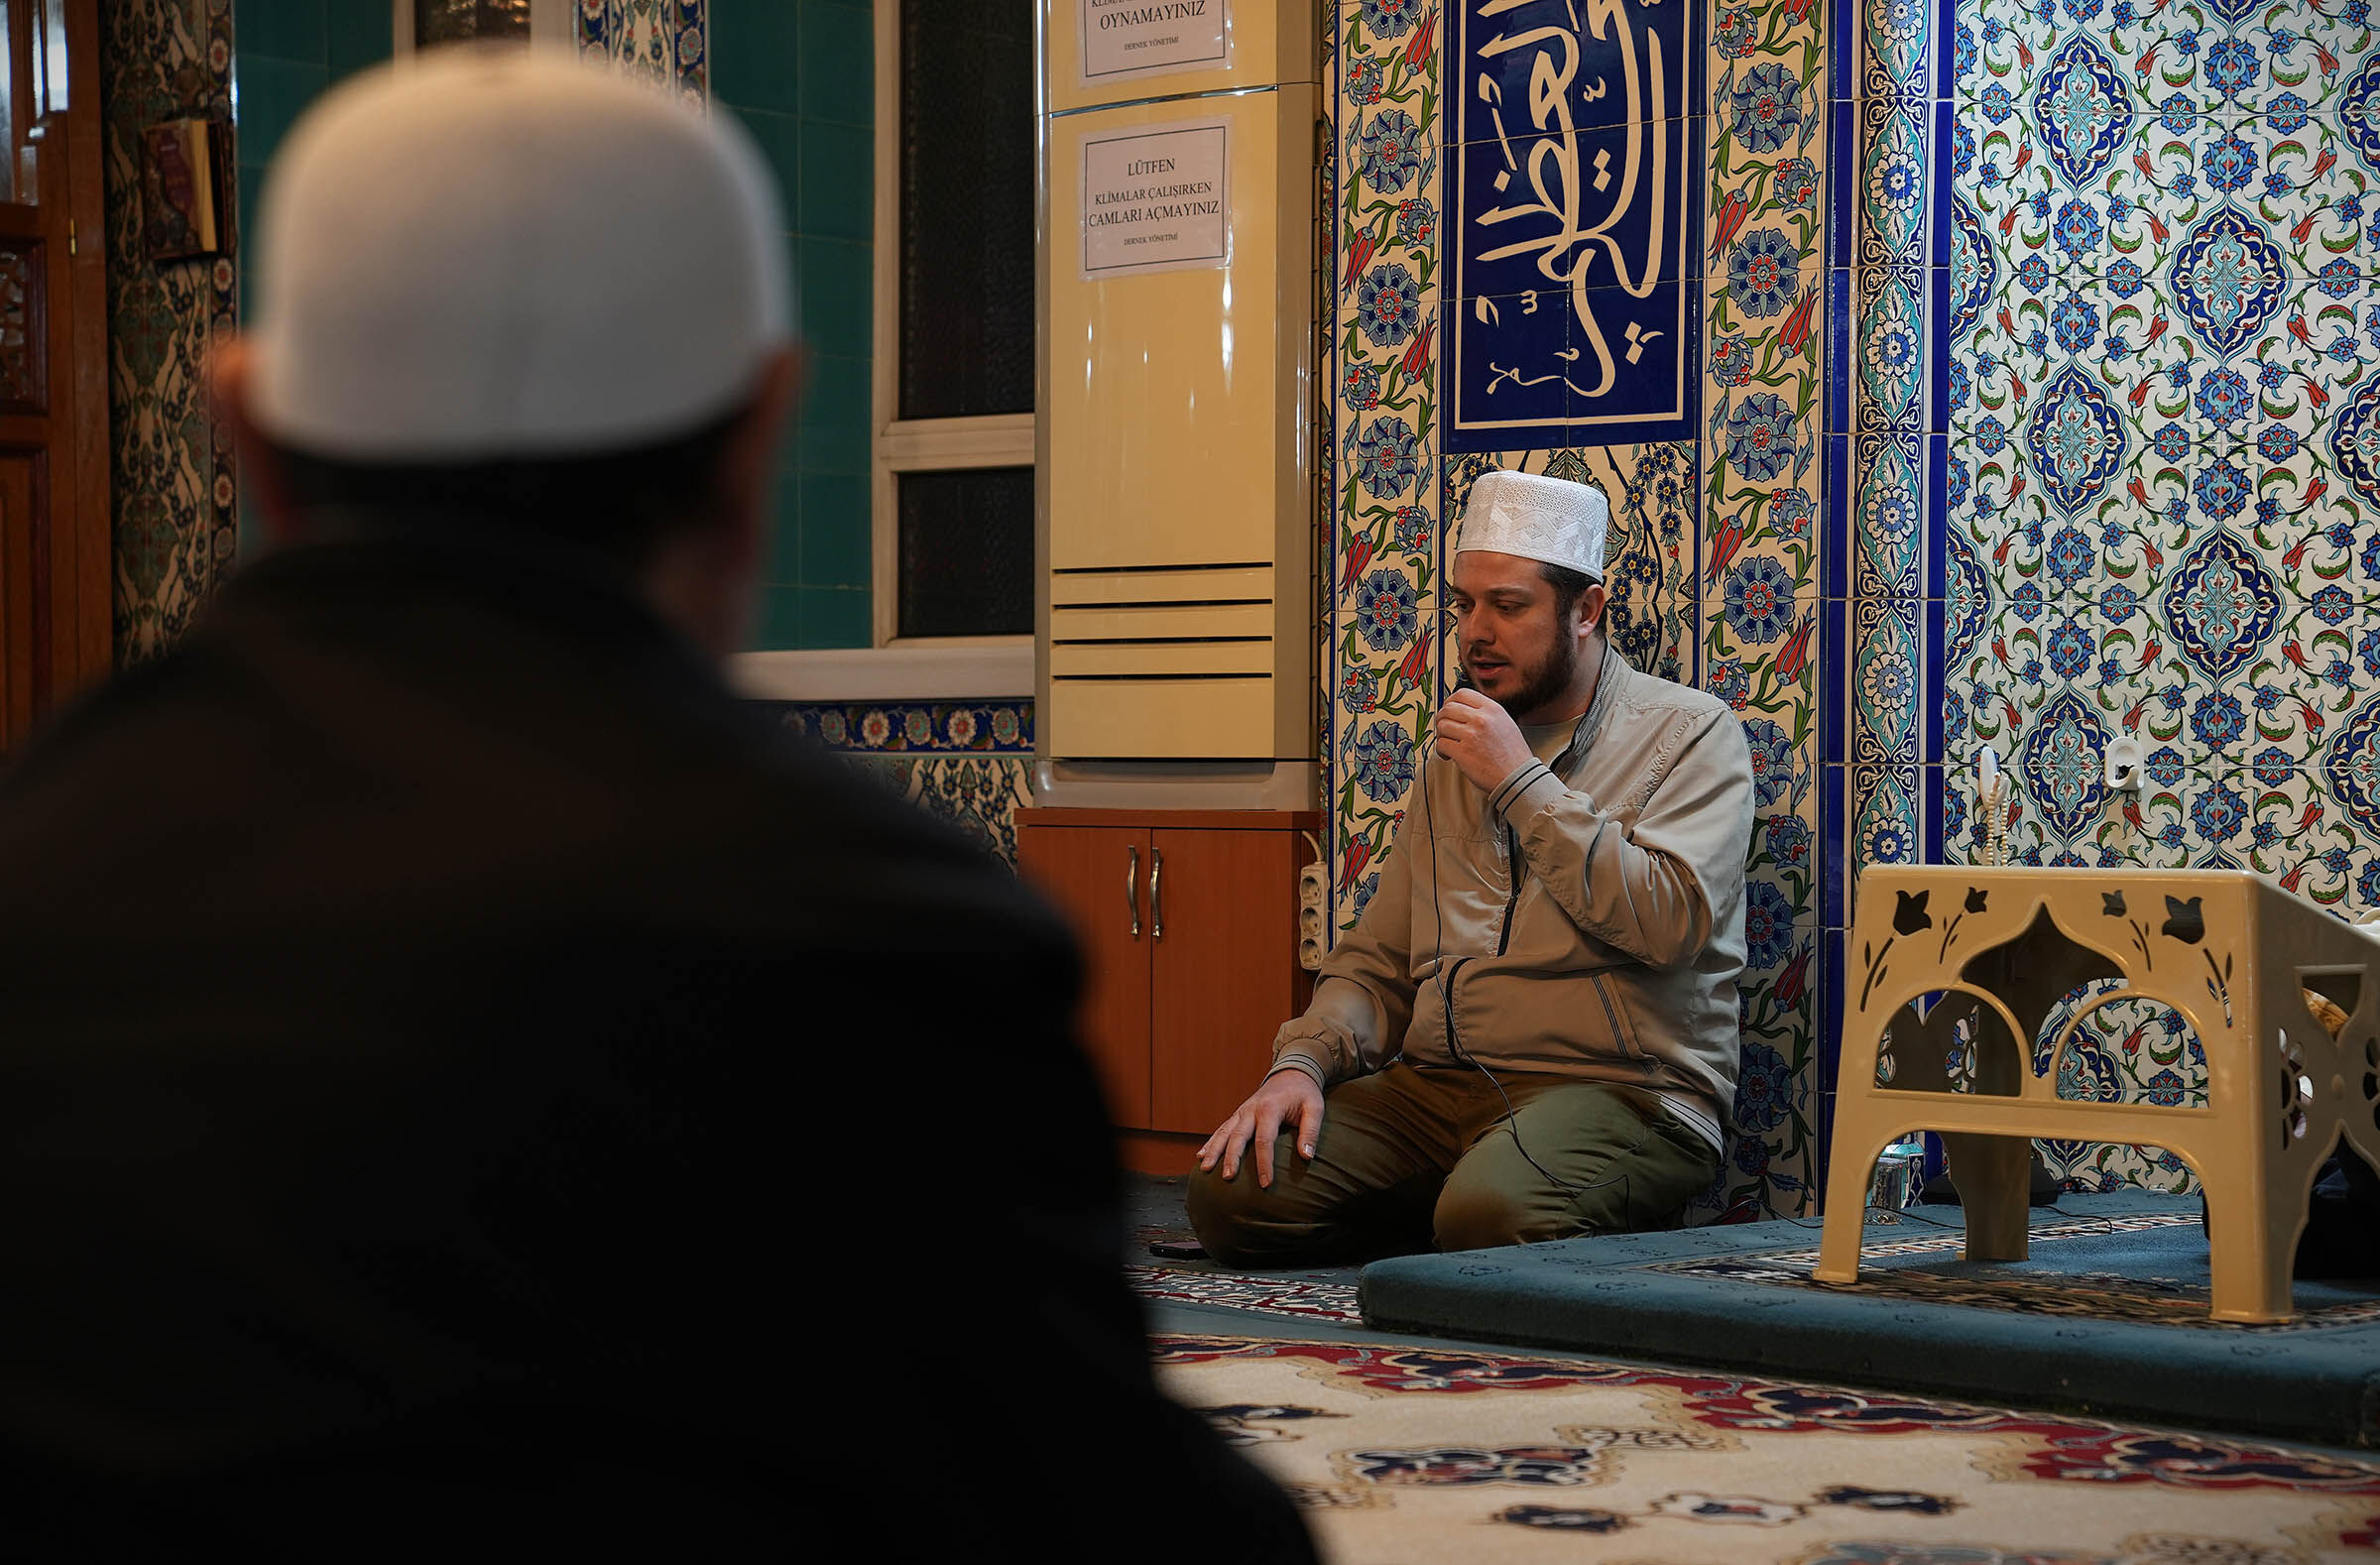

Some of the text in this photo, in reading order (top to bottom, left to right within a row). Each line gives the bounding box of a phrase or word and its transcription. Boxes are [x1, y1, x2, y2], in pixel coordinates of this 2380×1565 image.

[1100, 0, 1206, 30] OYNAMAYINIZ
[1125, 40, 1147, 51] DERNEK
[1128, 159, 1175, 177] LÜTFEN
[1095, 181, 1212, 205] KLİMALAR ÇALIŞIRKEN
[1088, 200, 1220, 228] CAMLARI AÇMAYINIZ
